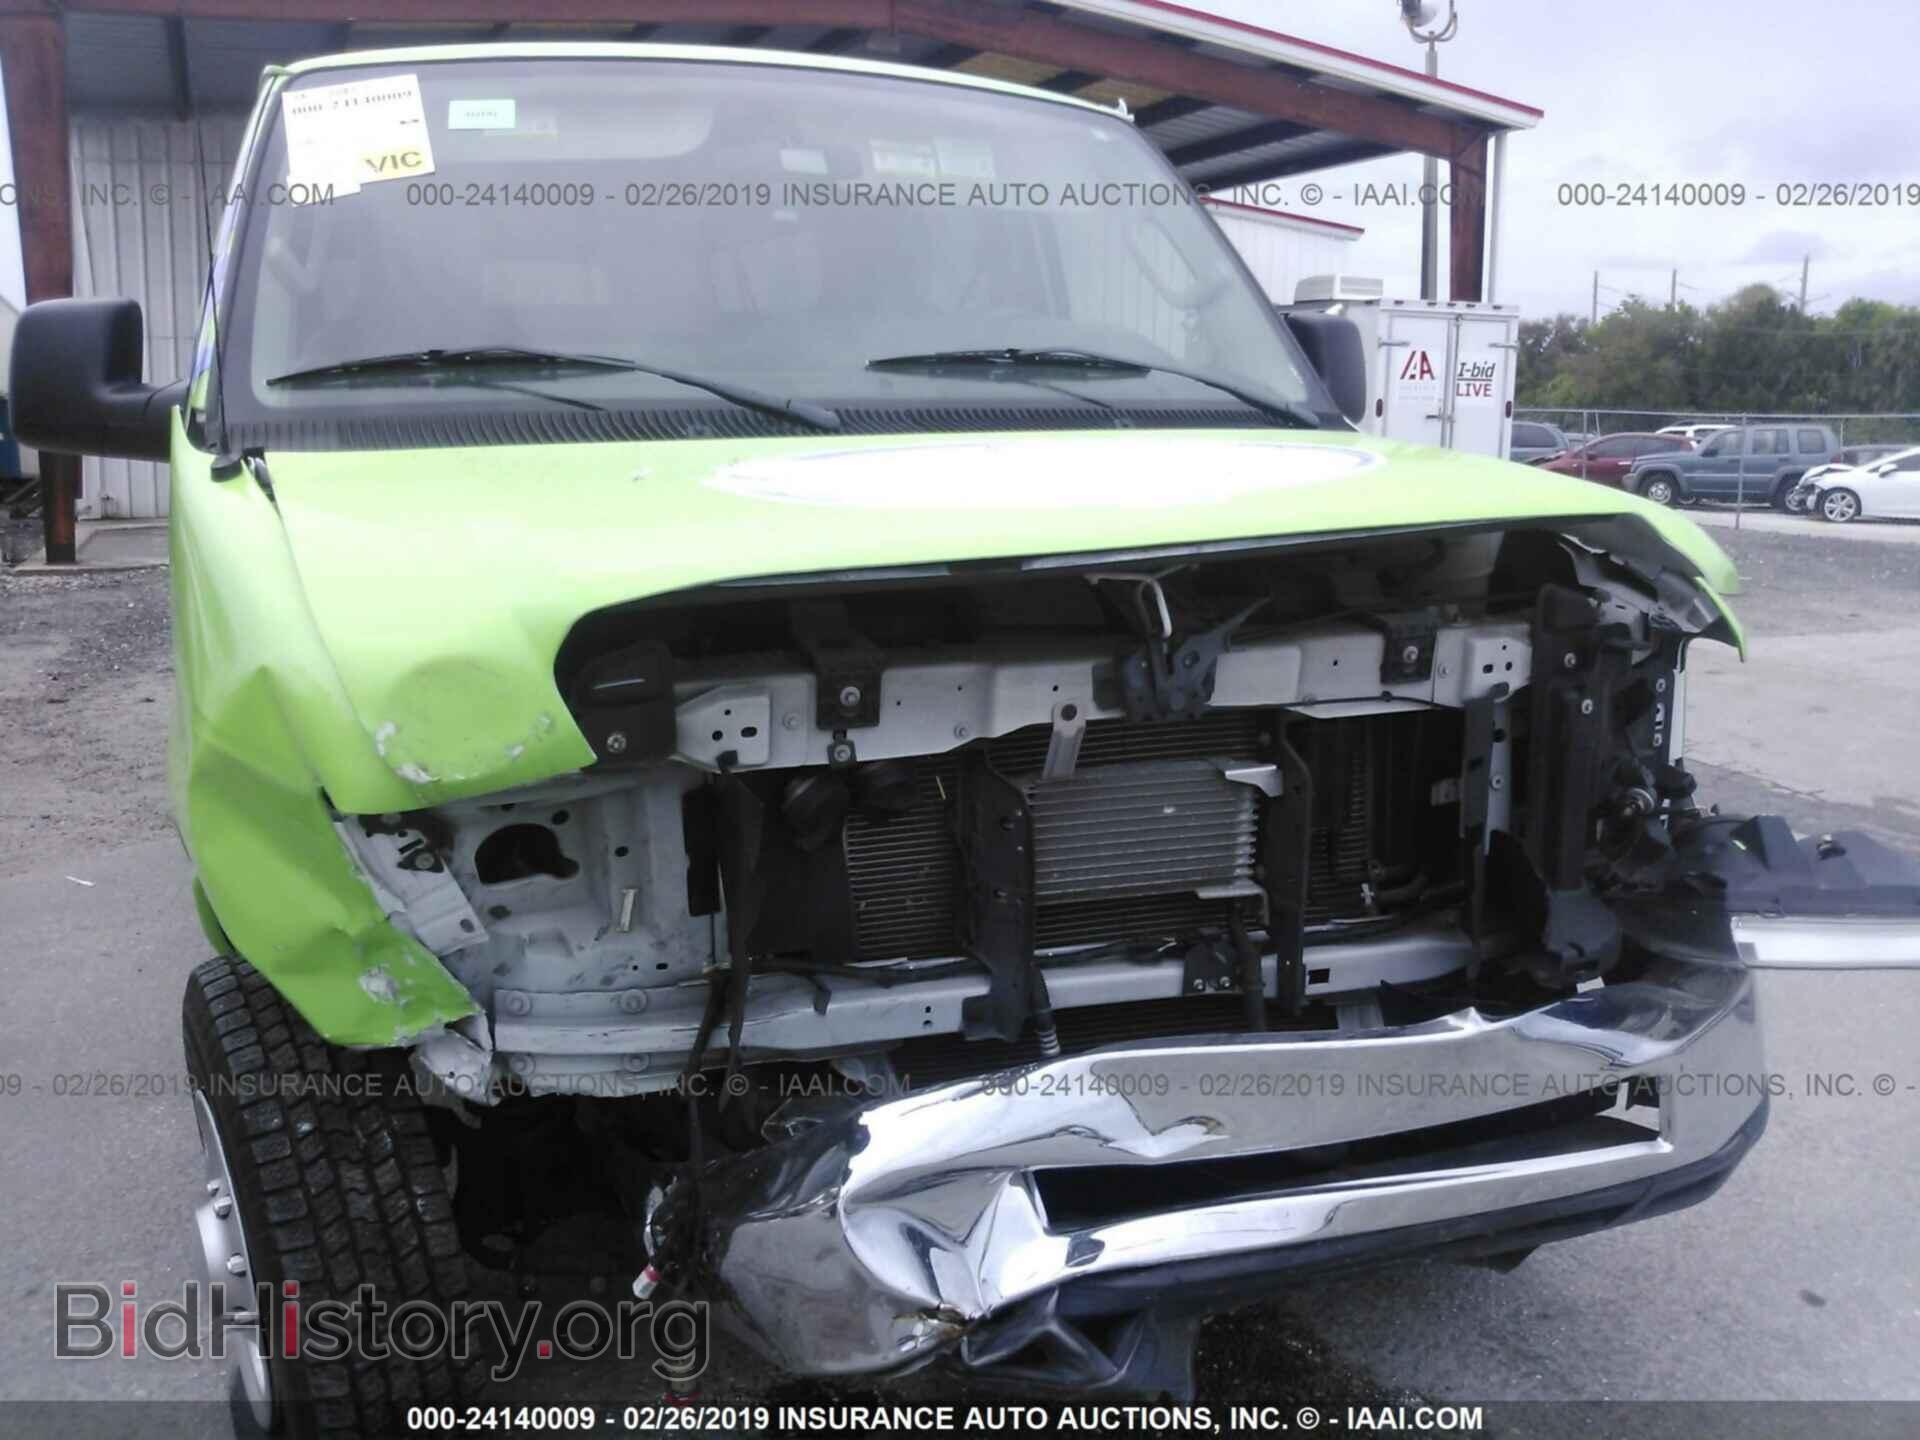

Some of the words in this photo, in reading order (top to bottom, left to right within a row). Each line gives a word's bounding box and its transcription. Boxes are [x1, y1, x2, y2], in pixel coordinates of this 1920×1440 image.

[365, 151, 423, 173] VIC
[1457, 361, 1496, 378] I-bid
[1455, 383, 1493, 398] LIVE
